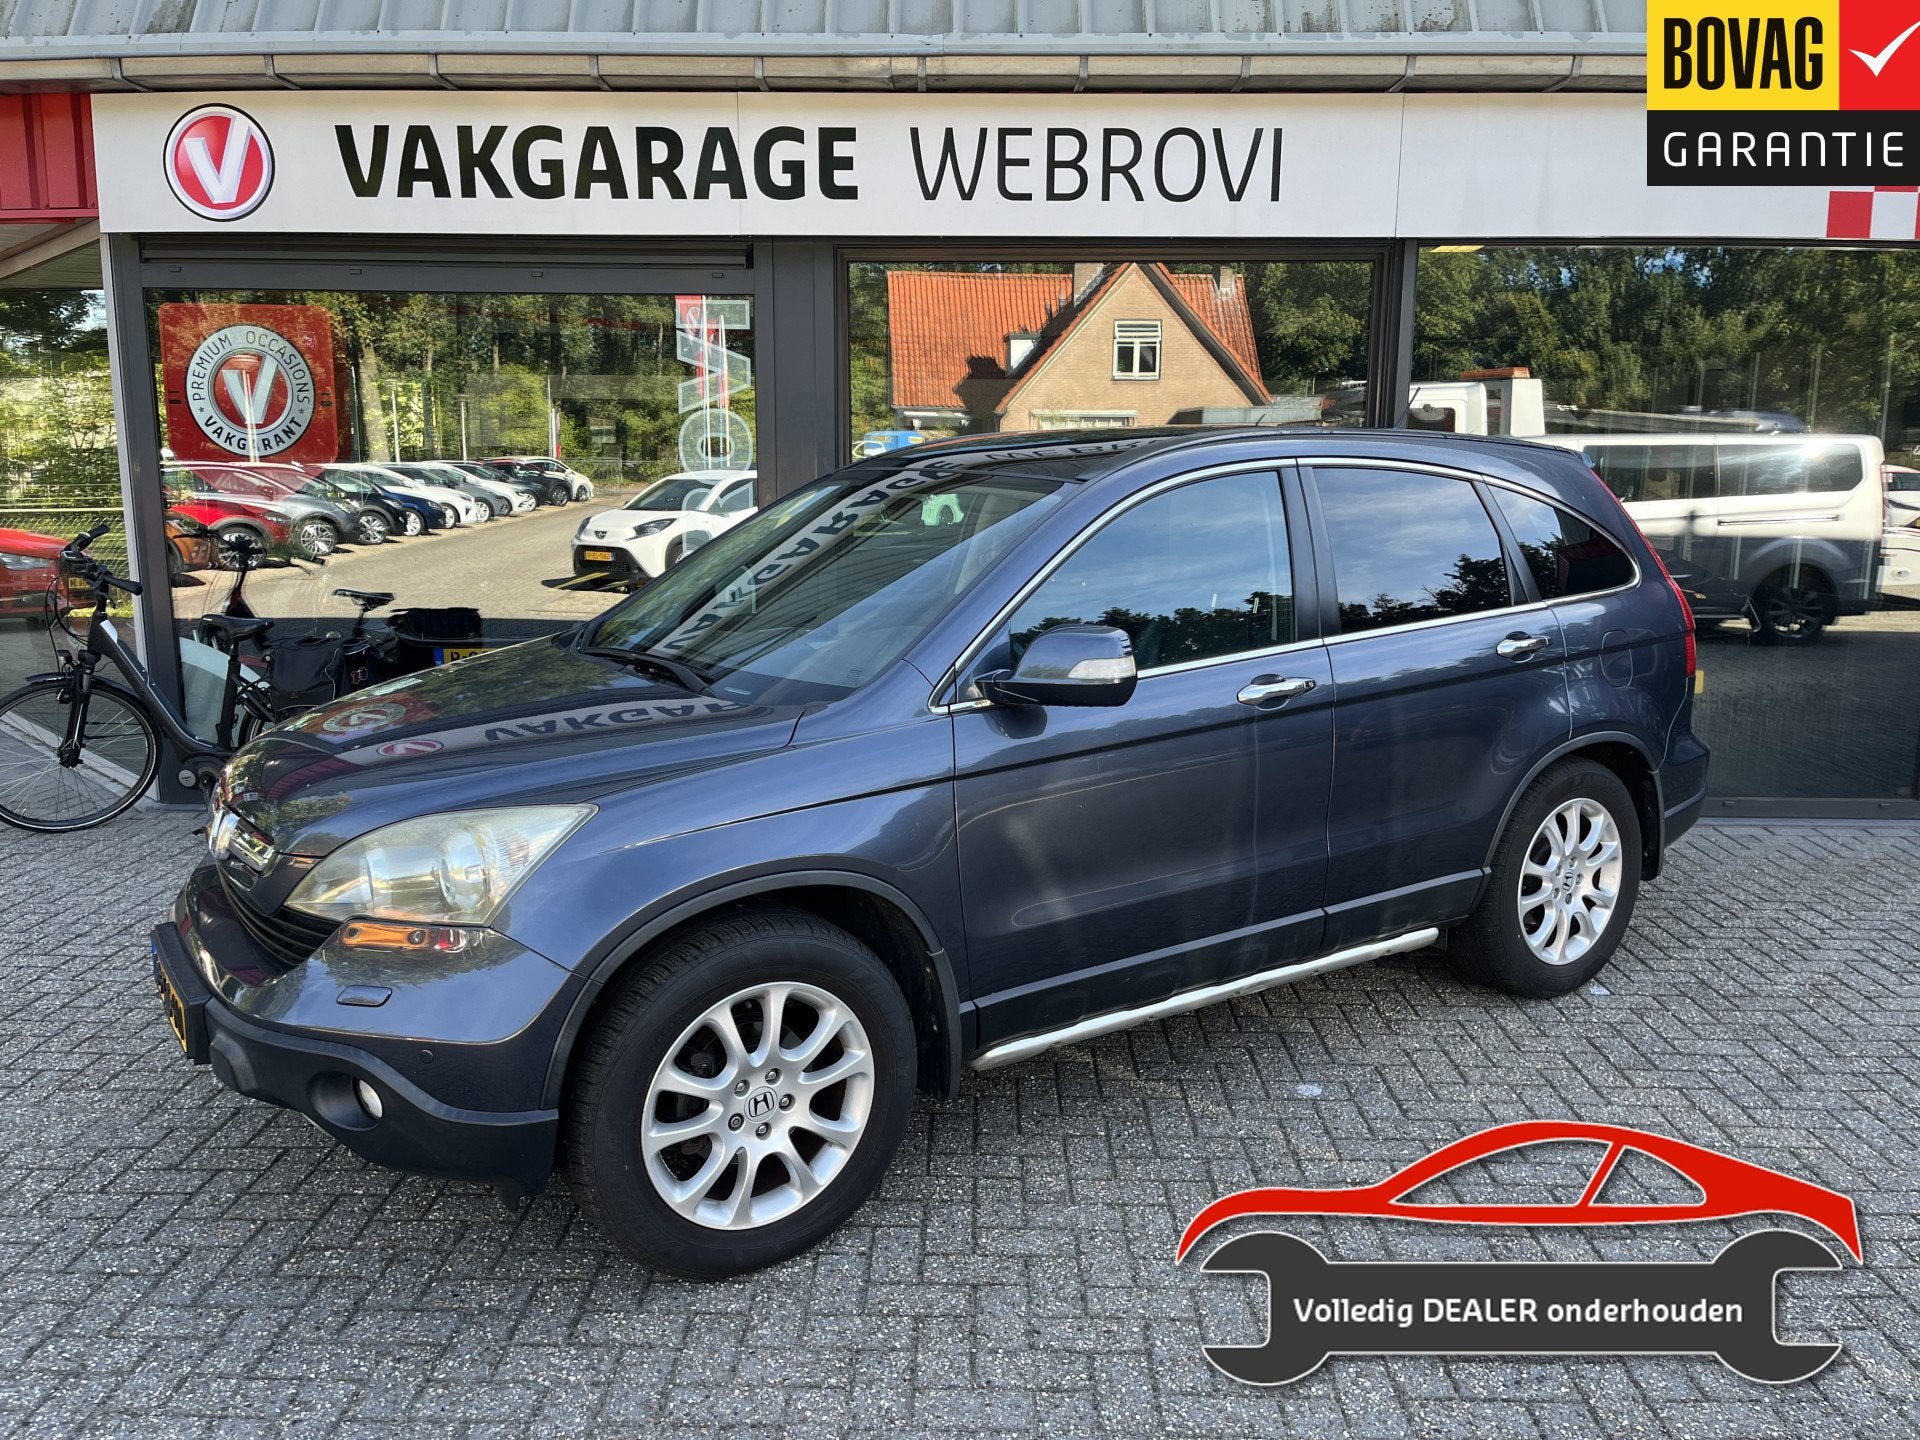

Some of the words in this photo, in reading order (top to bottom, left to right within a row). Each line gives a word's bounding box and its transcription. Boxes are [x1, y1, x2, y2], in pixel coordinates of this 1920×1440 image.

[335, 125, 857, 200] VAKGARAGE
[910, 128, 1282, 202] WEBROVI
[191, 333, 232, 401] PREMIUM
[245, 330, 310, 404] OCCASIONS
